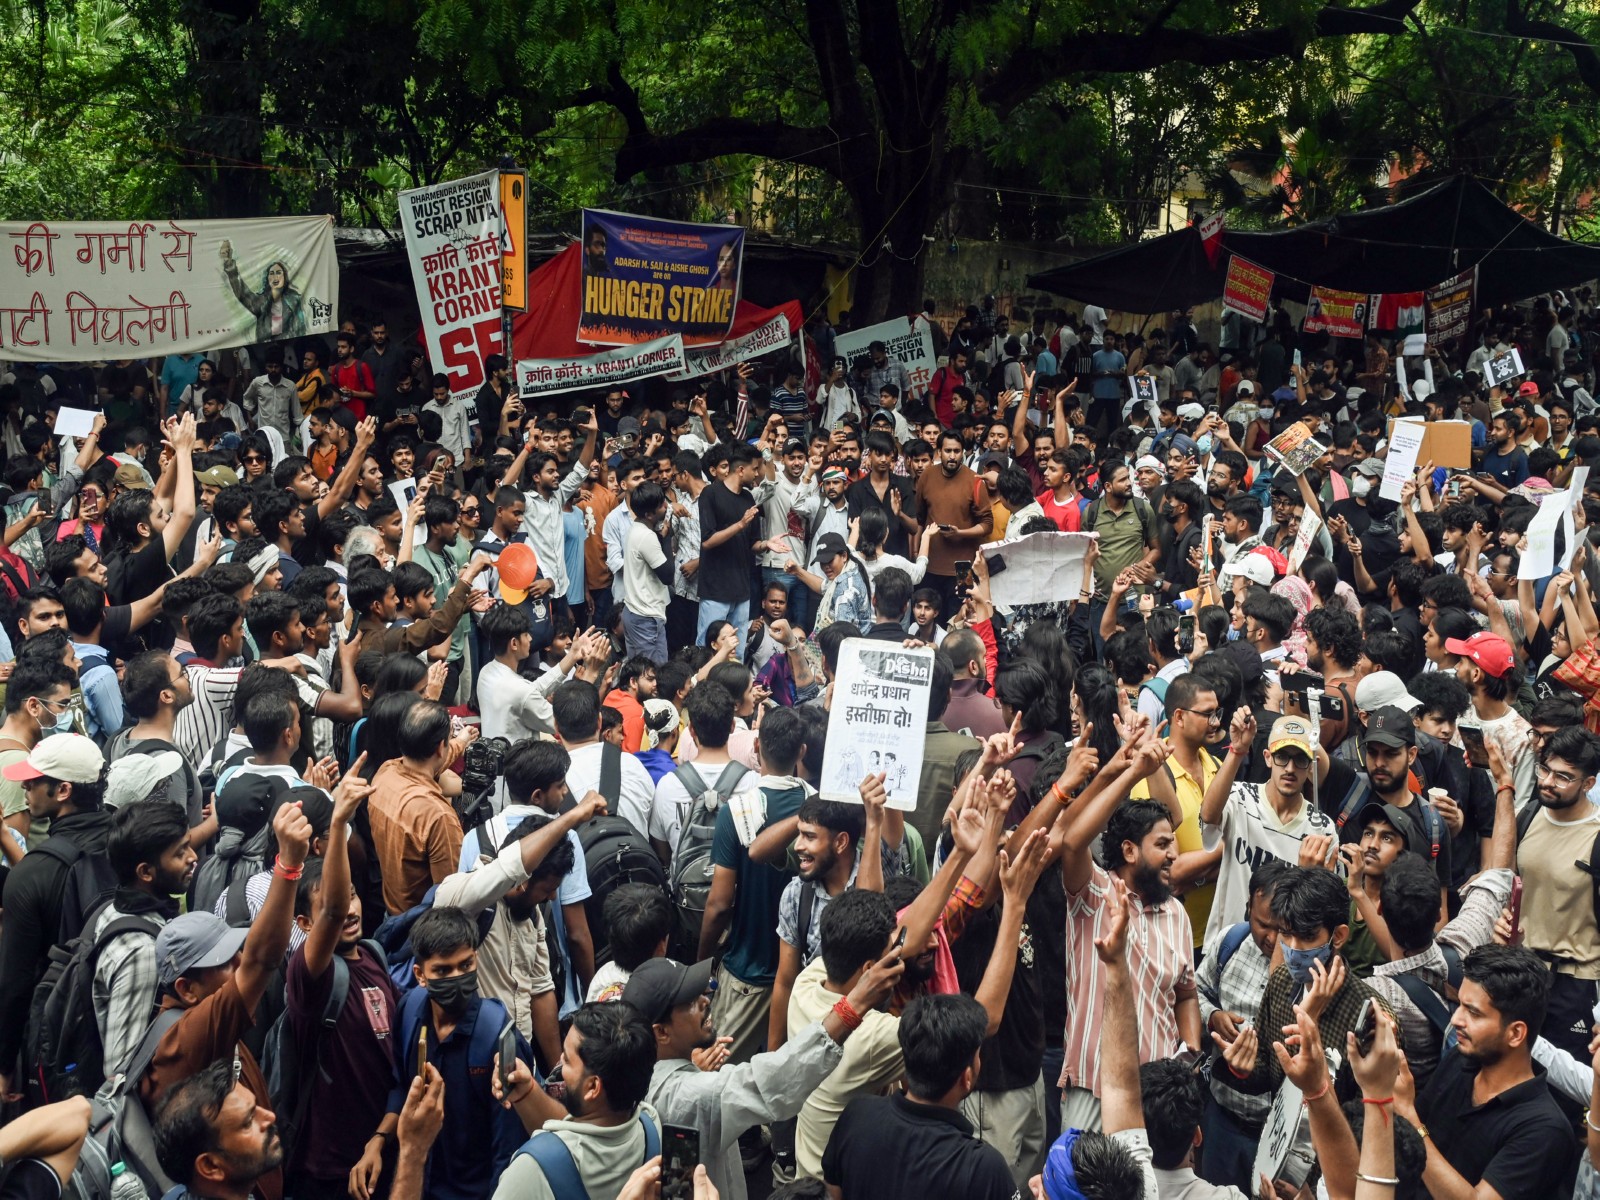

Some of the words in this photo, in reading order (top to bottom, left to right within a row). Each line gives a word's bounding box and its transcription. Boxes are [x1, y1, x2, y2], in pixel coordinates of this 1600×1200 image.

[411, 186, 457, 205] DHARMENDRA
[458, 178, 490, 193] PRADHAN
[412, 198, 446, 220] MUST
[448, 187, 492, 211] RESIGN
[415, 211, 462, 238] SCRAP
[466, 202, 498, 226] NTA
[9, 222, 60, 277] की
[75, 222, 156, 275] गर्मी
[160, 220, 197, 273] से
[421, 243, 460, 276] क्रांति
[466, 231, 500, 263] कॉर्न
[426, 259, 501, 303] KRANT
[614, 257, 640, 268] ADARSH
[641, 260, 649, 269] M.
[650, 261, 663, 270] SAJI
[664, 262, 669, 271] &
[670, 263, 688, 273] AISHE
[689, 264, 709, 275] GHOSH
[433, 286, 502, 326] CORNE
[585, 275, 665, 321] HUNGER
[667, 285, 734, 324] STRIKE
[748, 330, 788, 353] STRUGGLE
[885, 337, 923, 356] RESIGN
[892, 331, 922, 345] PRADHAN
[525, 365, 553, 385] क्रांति
[554, 361, 583, 380] कॉर्नर
[595, 357, 636, 375] KRANTI
[637, 347, 676, 365] CORNER
[898, 347, 926, 363] NTA
[881, 685, 911, 701] प्रधान
[846, 702, 892, 725] इस्तीफ़ा
[893, 706, 912, 728] दो!
